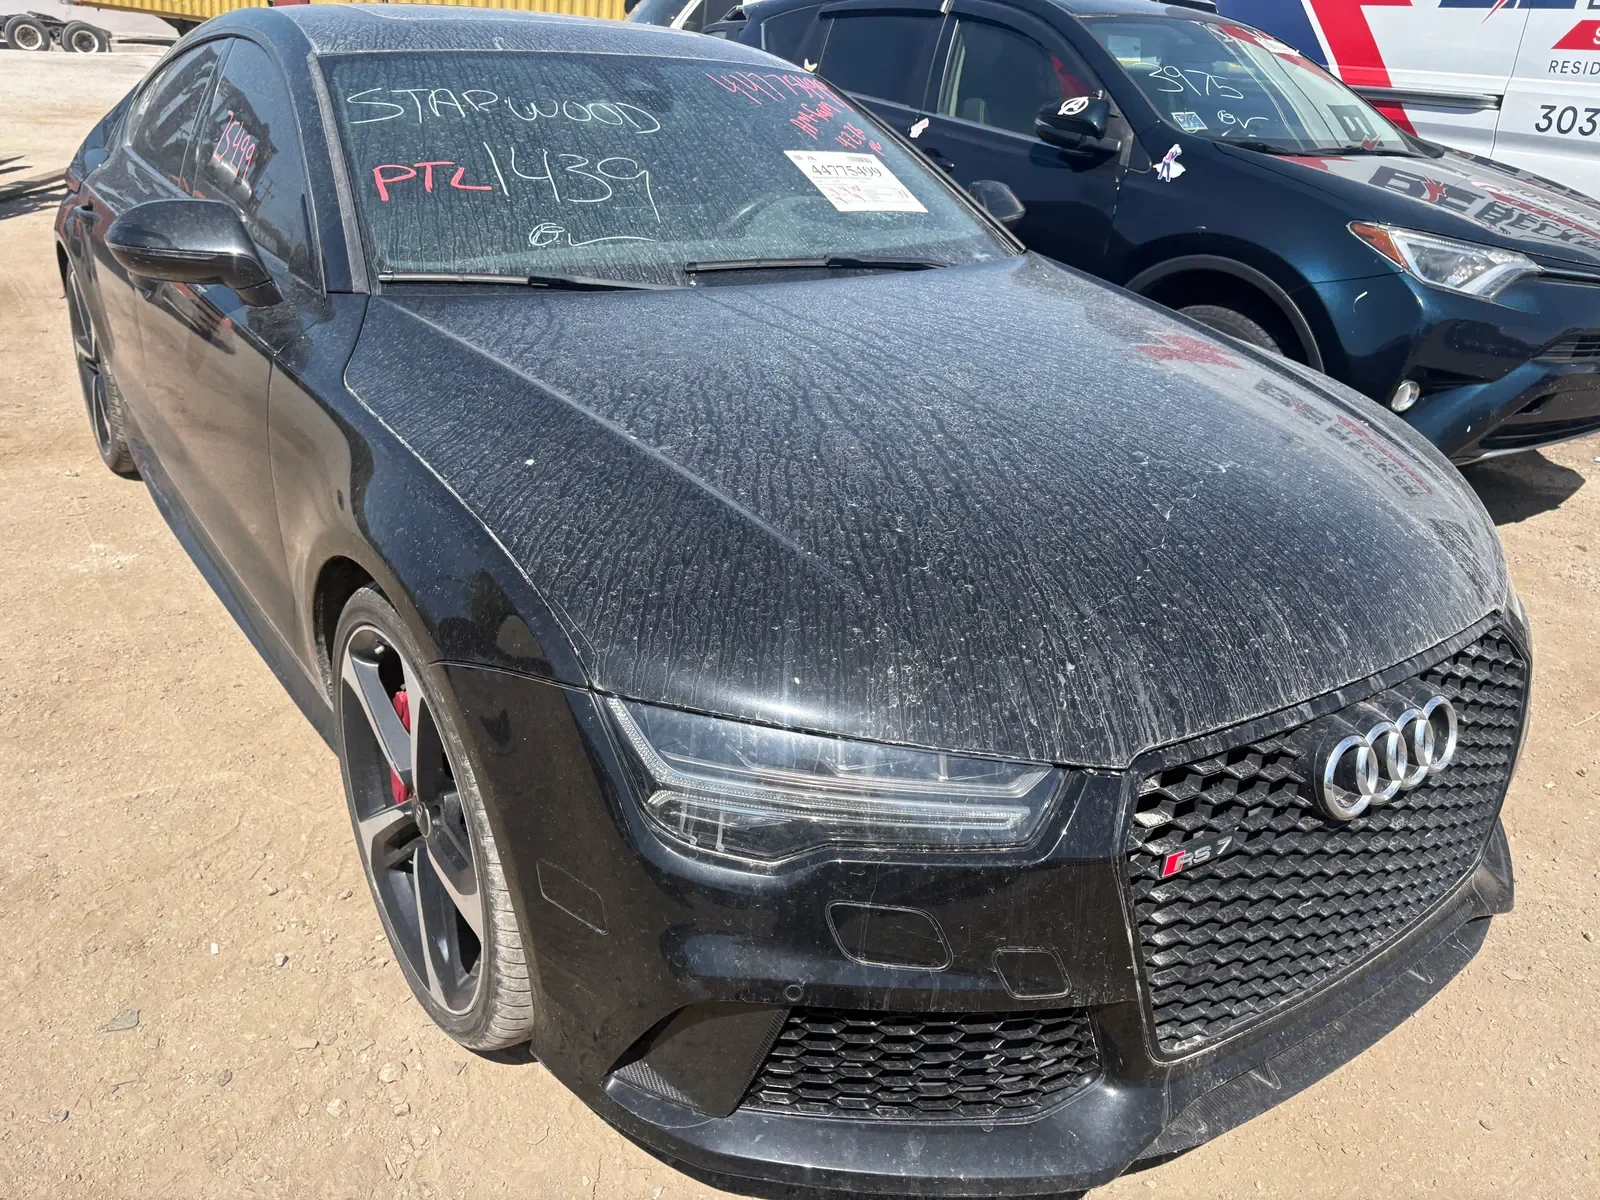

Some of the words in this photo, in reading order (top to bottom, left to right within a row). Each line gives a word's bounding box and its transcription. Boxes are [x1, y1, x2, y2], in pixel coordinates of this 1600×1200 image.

[1132, 62, 1244, 100] 3975
[372, 161, 493, 202] PTL
[482, 141, 661, 224] 1439
[811, 164, 883, 178] 44775499
